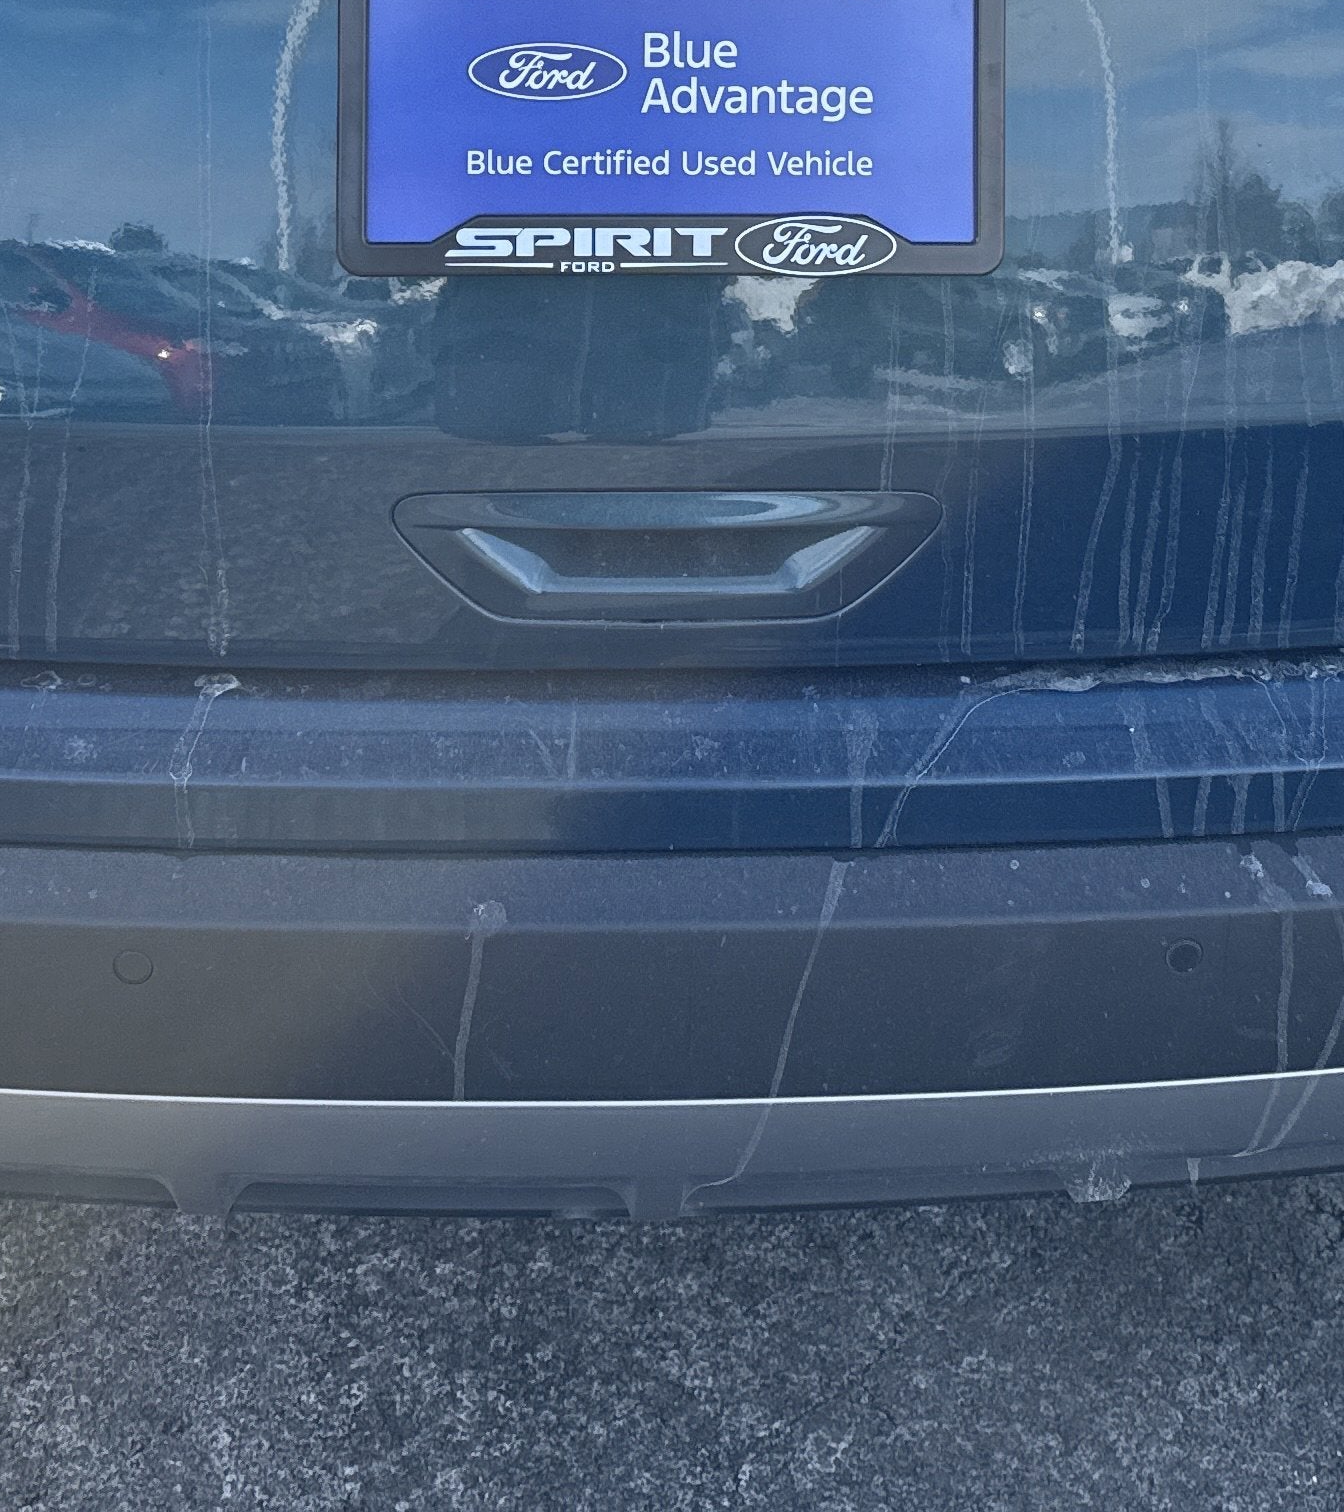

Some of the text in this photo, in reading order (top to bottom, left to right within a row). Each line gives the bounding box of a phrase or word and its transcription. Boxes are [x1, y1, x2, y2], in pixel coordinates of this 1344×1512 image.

[643, 31, 738, 69] Blue
[498, 50, 595, 91] Ford
[640, 77, 874, 122] Advantage
[466, 149, 873, 176] Blue Certified Used Vehicle
[445, 220, 868, 267] SPIRIT Ford
[559, 260, 616, 273] FORD
